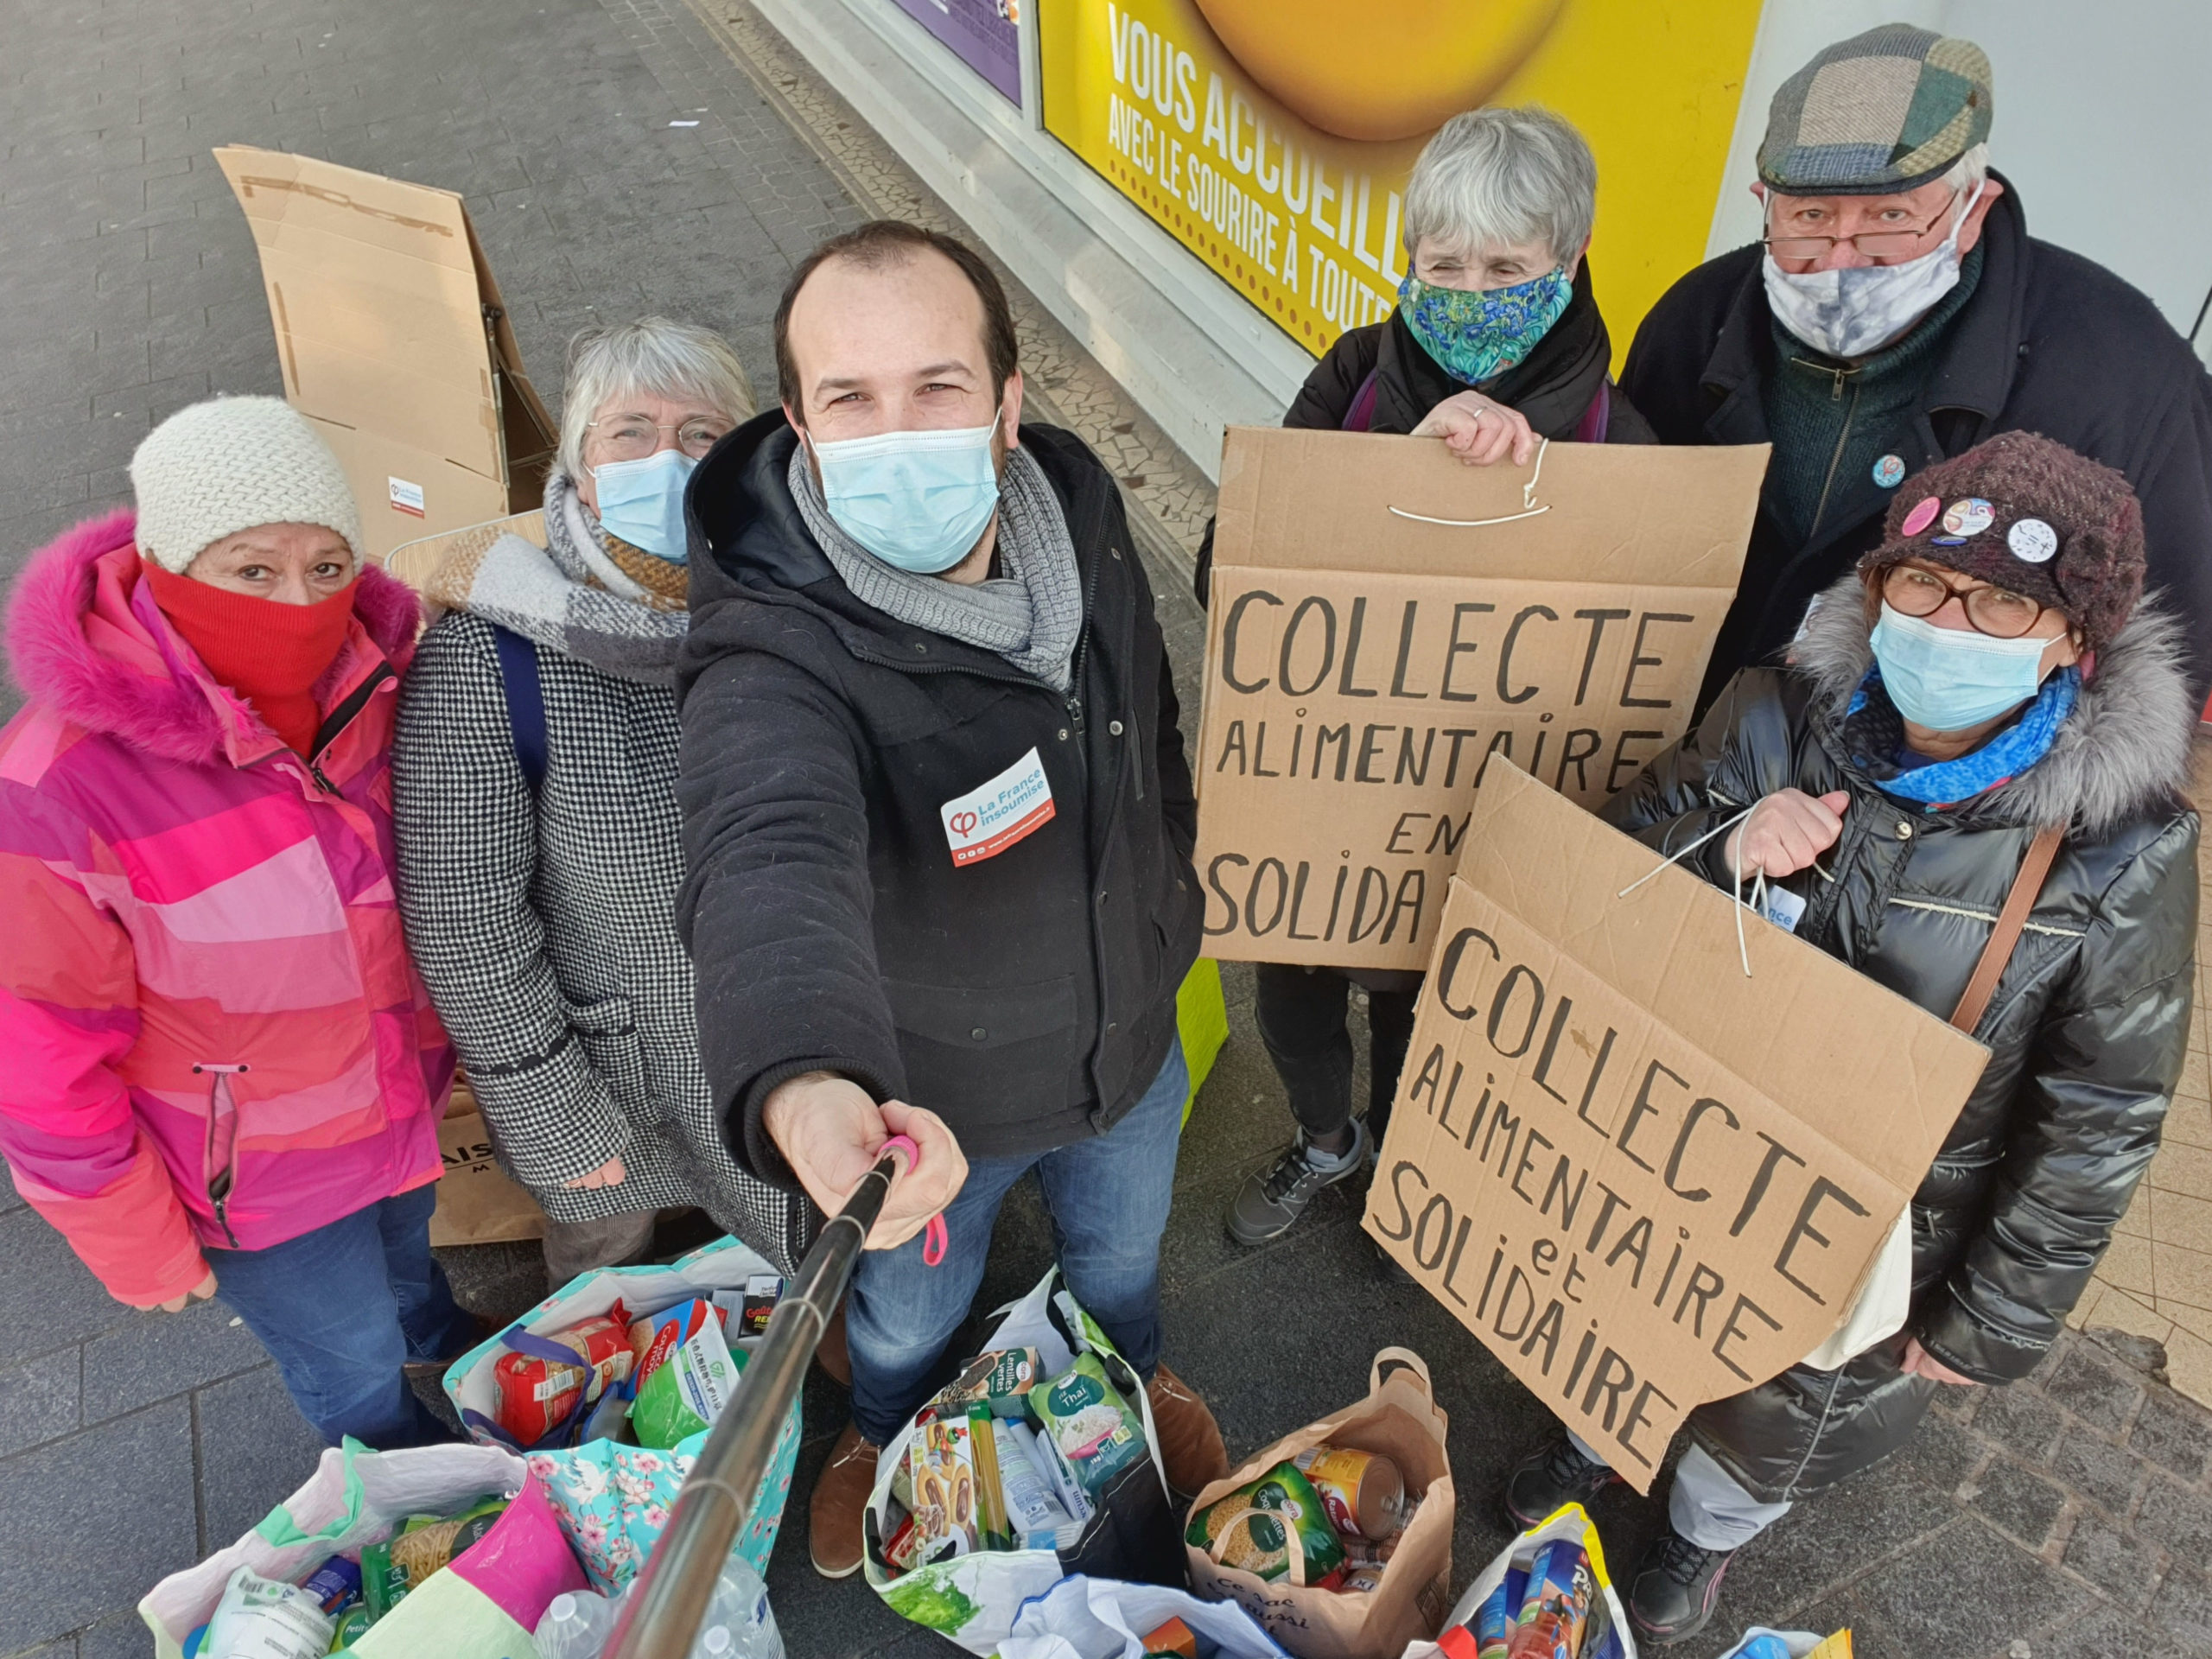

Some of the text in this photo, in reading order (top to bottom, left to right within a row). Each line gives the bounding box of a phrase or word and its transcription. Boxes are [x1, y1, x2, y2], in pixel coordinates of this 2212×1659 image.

[1109, 2, 1196, 133] VOUS
[1109, 92, 1154, 175] AVEC
[1160, 130, 1181, 199] LE
[1187, 153, 1280, 278] SOURIRE
[1282, 215, 1298, 294] À
[1222, 590, 1694, 709] COLLECTE
[978, 769, 1040, 815] La France
[981, 780, 1045, 827] insoumise
[1437, 927, 1871, 1306] COLLECTE
[1531, 1238, 1582, 1303] et
[996, 1363, 1005, 1392] vertes
[1006, 1352, 1016, 1391] Lentilles
[1284, 1500, 1299, 1519] cora
[1217, 1578, 1244, 1592] Ce
[1253, 1592, 1295, 1607] sac
